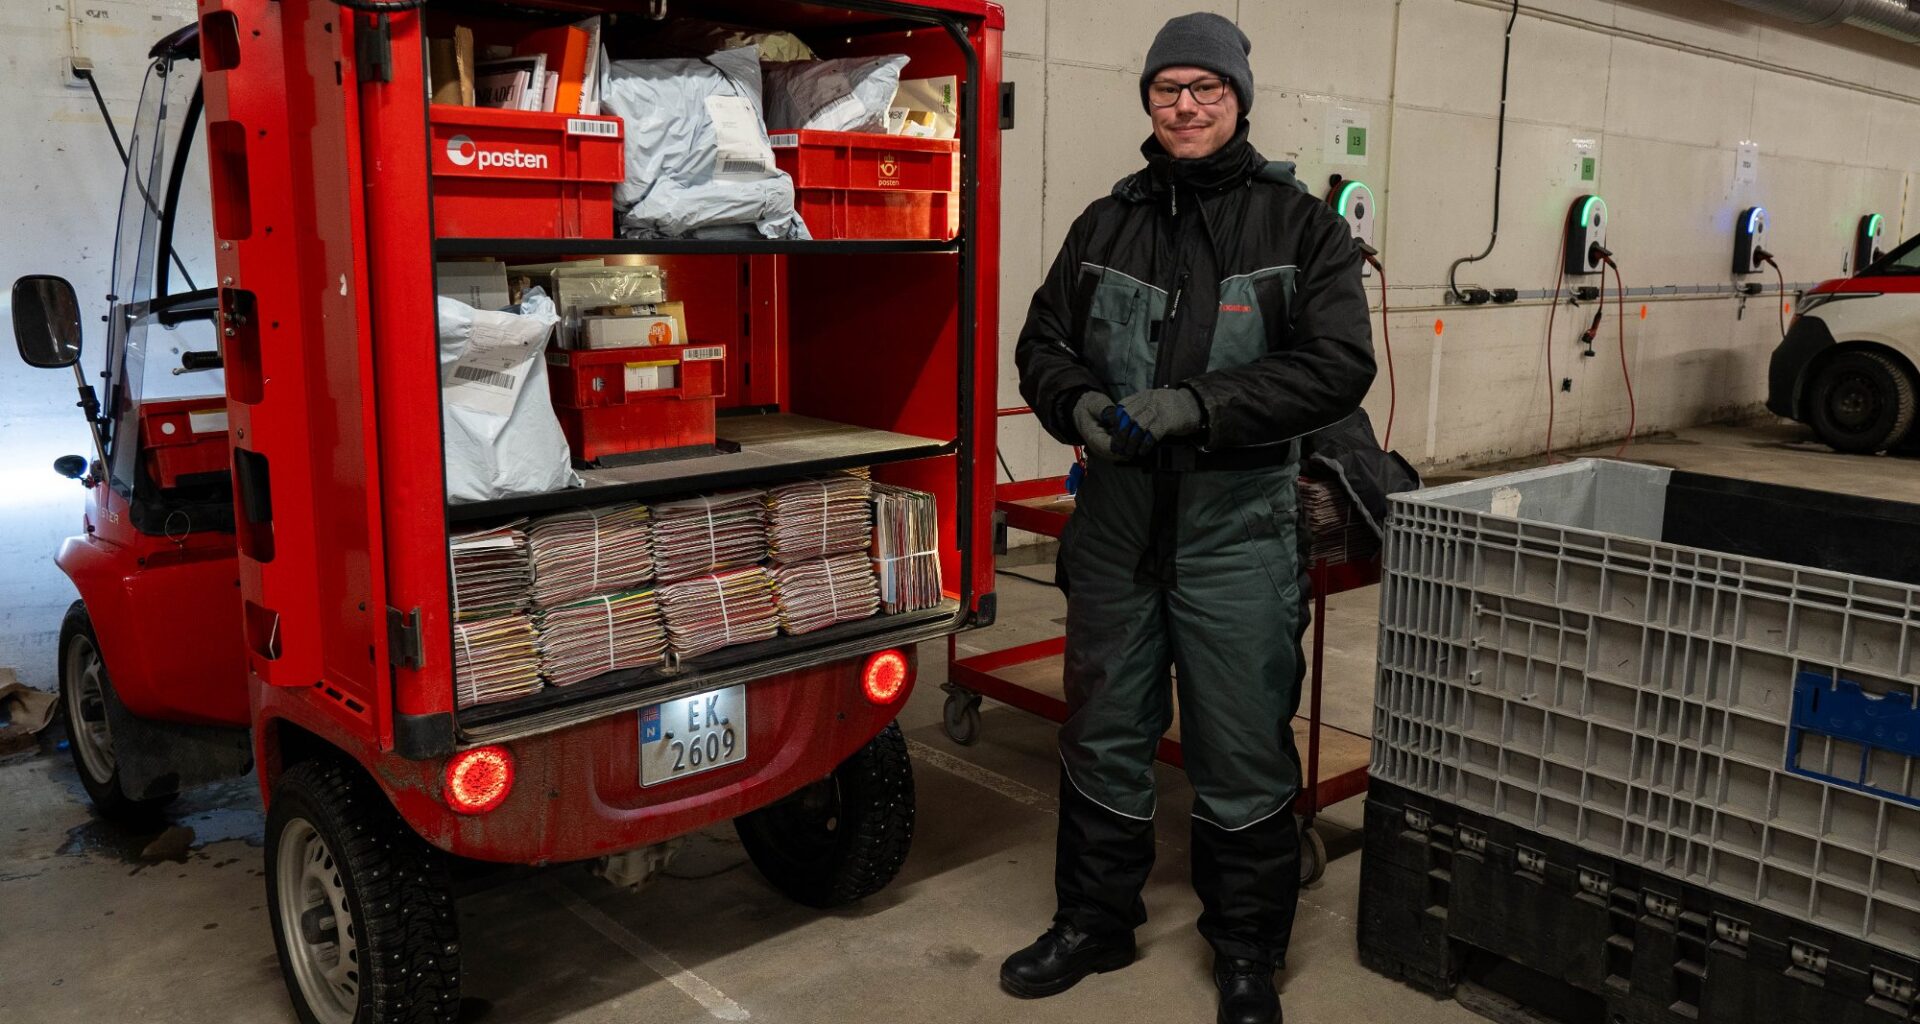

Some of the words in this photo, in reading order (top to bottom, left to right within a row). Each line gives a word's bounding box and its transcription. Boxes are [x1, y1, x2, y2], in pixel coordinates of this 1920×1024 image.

[1335, 134, 1340, 144] 6
[1352, 136, 1361, 146] 13
[478, 149, 548, 170] posten
[878, 179, 900, 187] posten
[688, 694, 719, 733] EK
[646, 727, 656, 738] N
[671, 728, 735, 771] 2609
